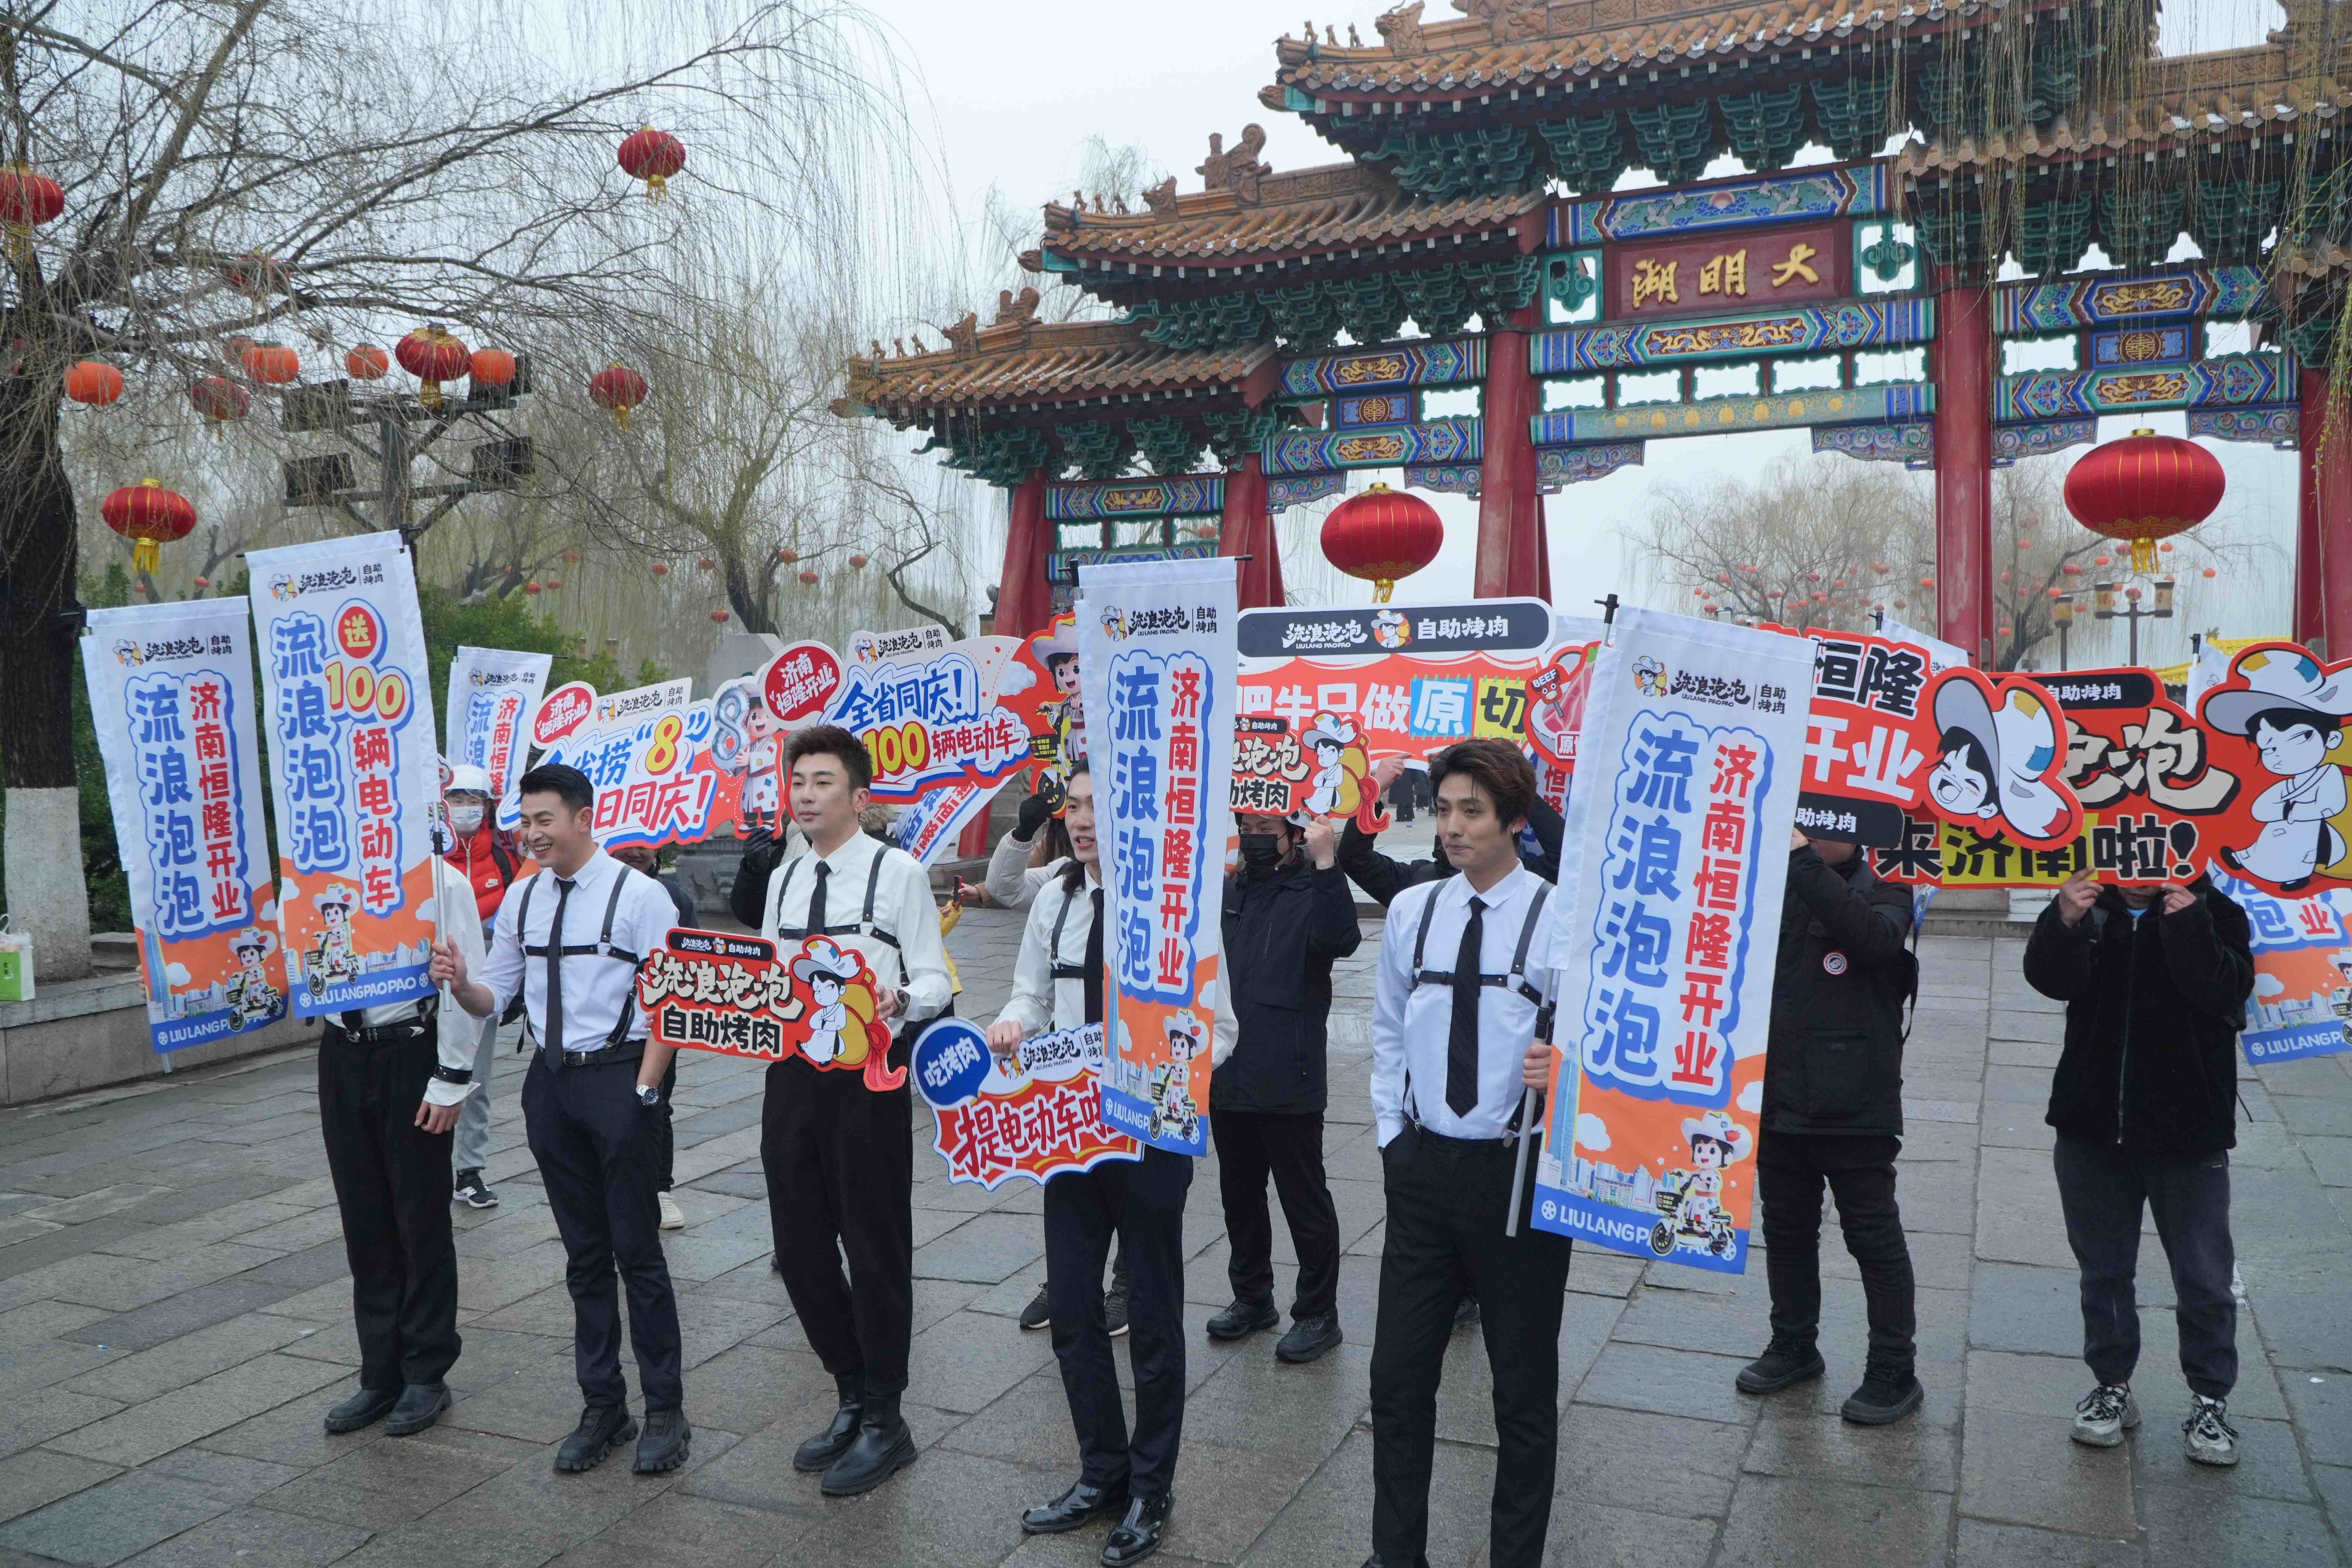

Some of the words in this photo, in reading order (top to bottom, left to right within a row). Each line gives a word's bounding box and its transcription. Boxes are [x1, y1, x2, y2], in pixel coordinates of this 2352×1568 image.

[299, 567, 356, 594] 流浪泡泡
[363, 574, 383, 585] 烤肉
[364, 563, 382, 574] 自助
[1128, 606, 1190, 635] 流浪泡泡
[1196, 621, 1217, 633] 烤肉
[1197, 607, 1216, 620] 自助
[211, 635, 231, 645] 自助
[344, 614, 371, 648] 送
[926, 629, 941, 639] 自助
[927, 639, 943, 649] 烤肉
[1282, 620, 1367, 649] 流浪泡泡
[1418, 616, 1508, 640] 自助烤肉
[142, 636, 205, 662] 流浪泡泡
[211, 645, 232, 656] 烤肉
[878, 632, 923, 658] 流浪泡泡
[780, 653, 813, 688] 济南
[1532, 669, 1556, 688] BEEF
[325, 661, 405, 721] 100
[669, 686, 683, 697] 自助
[776, 664, 836, 717] 恒隆开业
[832, 668, 962, 733] 全省同庆!
[1671, 670, 1751, 705] 流浪泡泡
[1682, 693, 1707, 703] LIULANG
[1708, 698, 1734, 707] PAOPAO
[1761, 684, 1786, 700] 自助
[2045, 683, 2121, 702] 自助烤肉
[550, 692, 575, 719] 济南
[617, 690, 663, 717] 流浪泡泡
[667, 696, 683, 707] 烤肉
[1758, 699, 1785, 714] 烤肉
[538, 700, 588, 740] 恒隆开业
[1252, 721, 1277, 730] 自助烤肉
[276, 619, 341, 864] 流浪泡泡
[862, 721, 931, 780] 100
[932, 718, 1021, 762] 辆电动车
[135, 684, 204, 929] 流浪泡泡
[190, 682, 242, 919] 济南恒隆开业
[353, 727, 395, 907] 辆电动车
[1115, 666, 1161, 983] 流浪泡泡
[1157, 667, 1200, 987] 济南恒隆开业
[1795, 808, 1857, 833] 助烤肉
[1592, 727, 1699, 1077] 流浪泡泡
[1672, 744, 1758, 1086] 济南恒隆开业
[2299, 903, 2336, 936] 业
[729, 943, 761, 956] 自助烤肉
[315, 977, 417, 1005] LIULANGPAOPAO
[641, 951, 806, 1023] 流浪泡泡
[664, 1006, 781, 1055] 自助烤肉
[2266, 1031, 2345, 1054] LIULANGP
[923, 1036, 982, 1088] 吃烤肉
[1023, 1037, 1081, 1070] 流浪泡泡
[1053, 1059, 1072, 1069] PAOPAO
[1087, 1046, 1102, 1058] 烤
